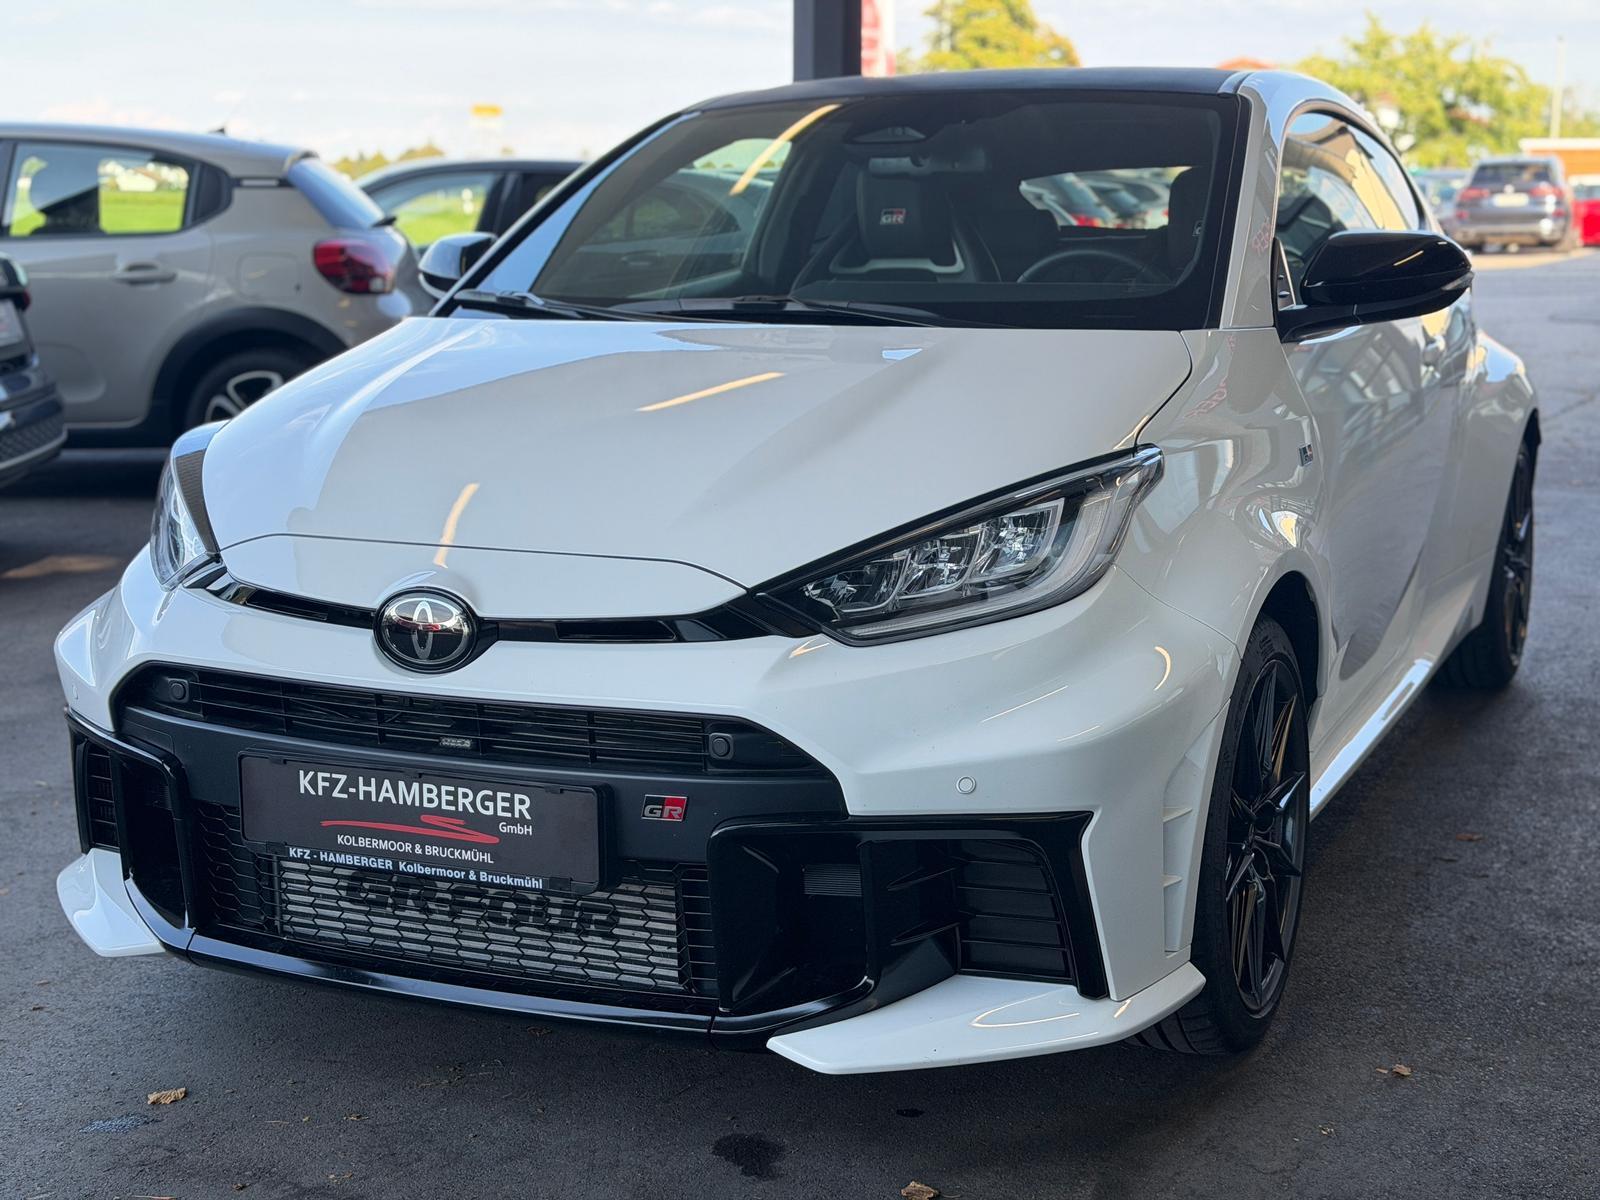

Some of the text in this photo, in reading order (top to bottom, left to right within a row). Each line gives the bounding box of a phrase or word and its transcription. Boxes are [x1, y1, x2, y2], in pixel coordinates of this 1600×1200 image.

[299, 769, 532, 820] KFZ-HAMBERGER
[643, 804, 683, 819] GR
[498, 821, 533, 836] GmbH
[337, 834, 495, 864] KOLBERMOOR & BRUCKMÜHL
[289, 847, 311, 859] KFZ
[320, 851, 393, 870] HAMBERGER
[398, 861, 466, 880] Kolbermoor
[468, 870, 477, 881] &
[479, 871, 543, 889] Bruckmühl
